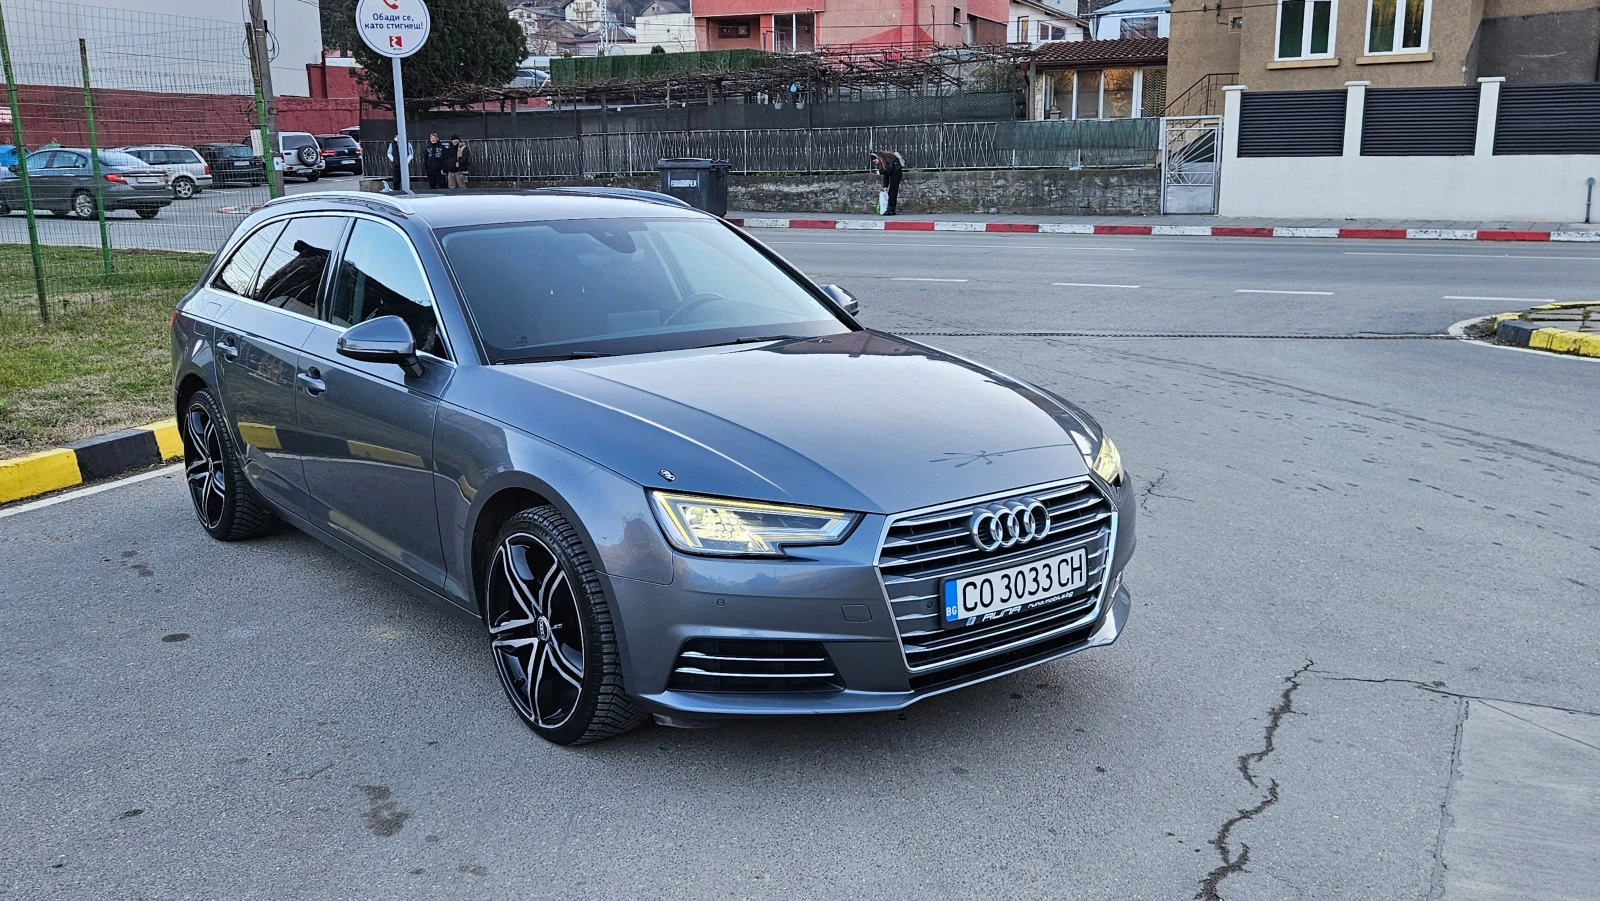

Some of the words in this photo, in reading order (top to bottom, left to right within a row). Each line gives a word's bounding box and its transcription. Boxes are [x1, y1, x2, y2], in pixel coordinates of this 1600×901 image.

[373, 13, 399, 22] Обади
[386, 22, 424, 30] стигнеш!
[962, 578, 994, 612] CO
[1000, 563, 1053, 603] 3033
[1057, 553, 1083, 588] CH
[945, 606, 958, 617] BG
